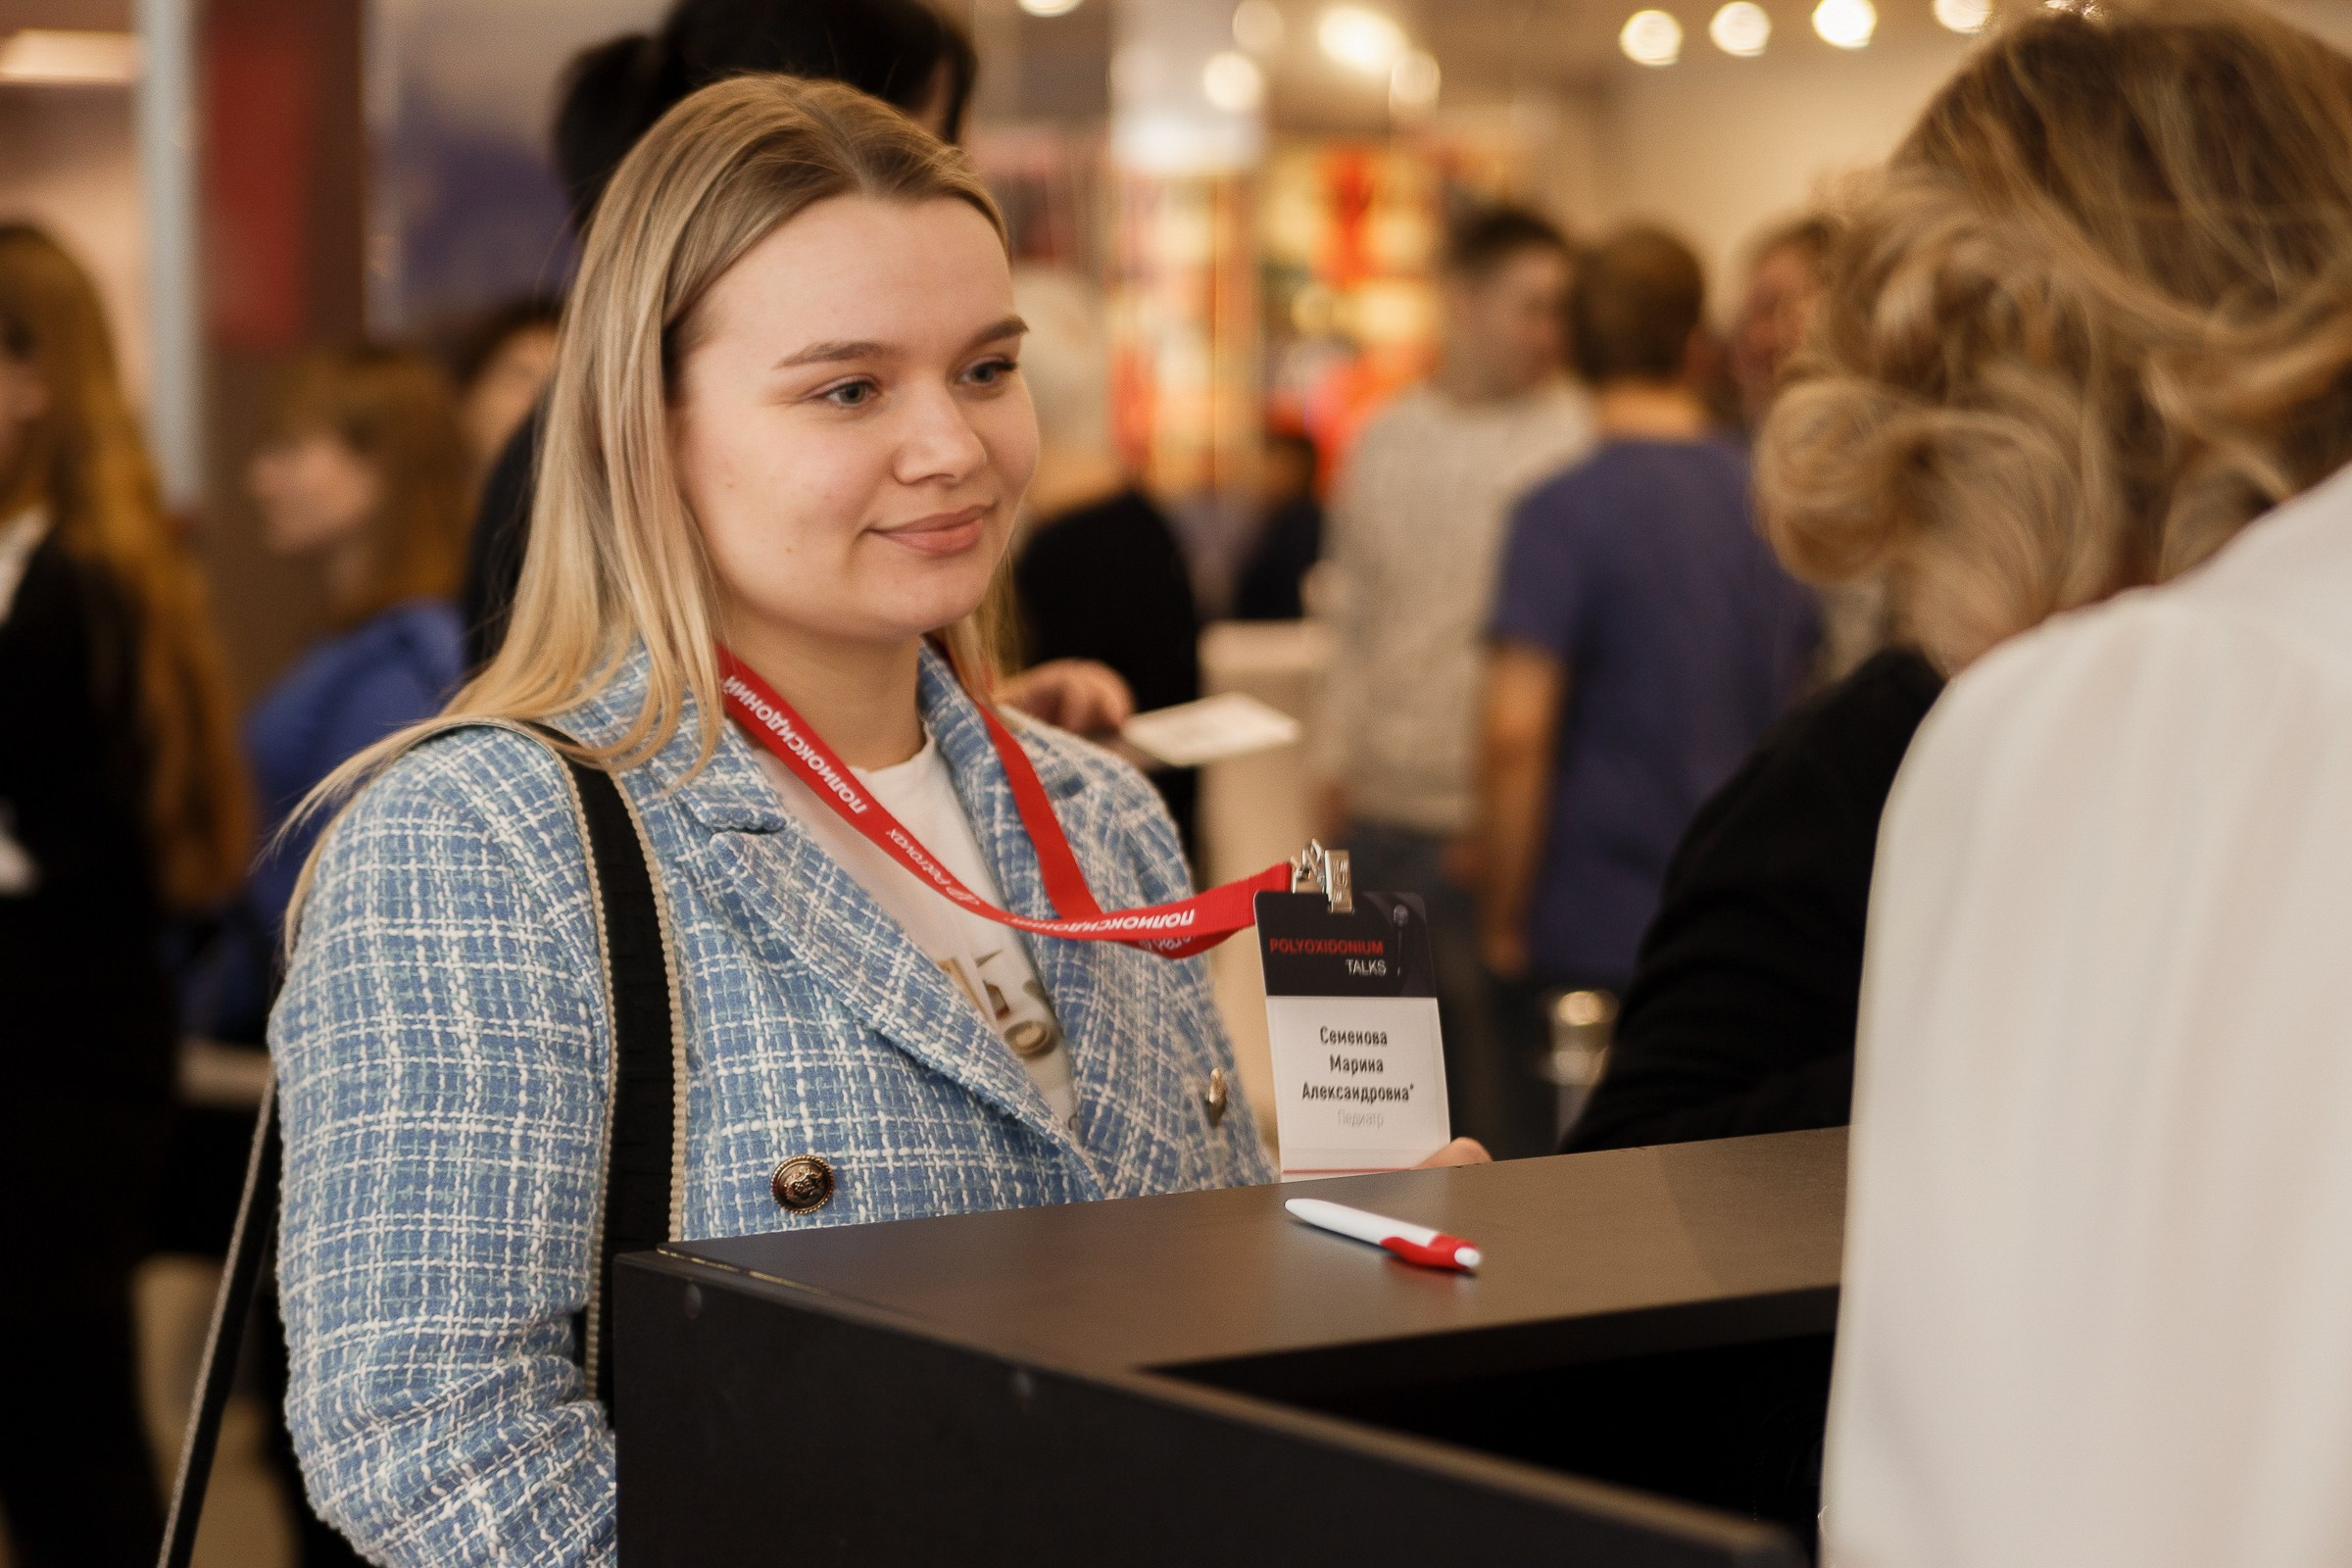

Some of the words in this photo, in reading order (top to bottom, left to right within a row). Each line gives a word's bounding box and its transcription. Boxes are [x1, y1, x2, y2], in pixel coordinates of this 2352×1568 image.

[720, 675, 868, 814] ПОЛИОКСИДОНИЙ
[1269, 937, 1384, 956] POLYOXIDONIUM
[1346, 958, 1387, 976] TALKS
[1319, 1025, 1388, 1046] Семенова
[1329, 1053, 1384, 1076] Марина
